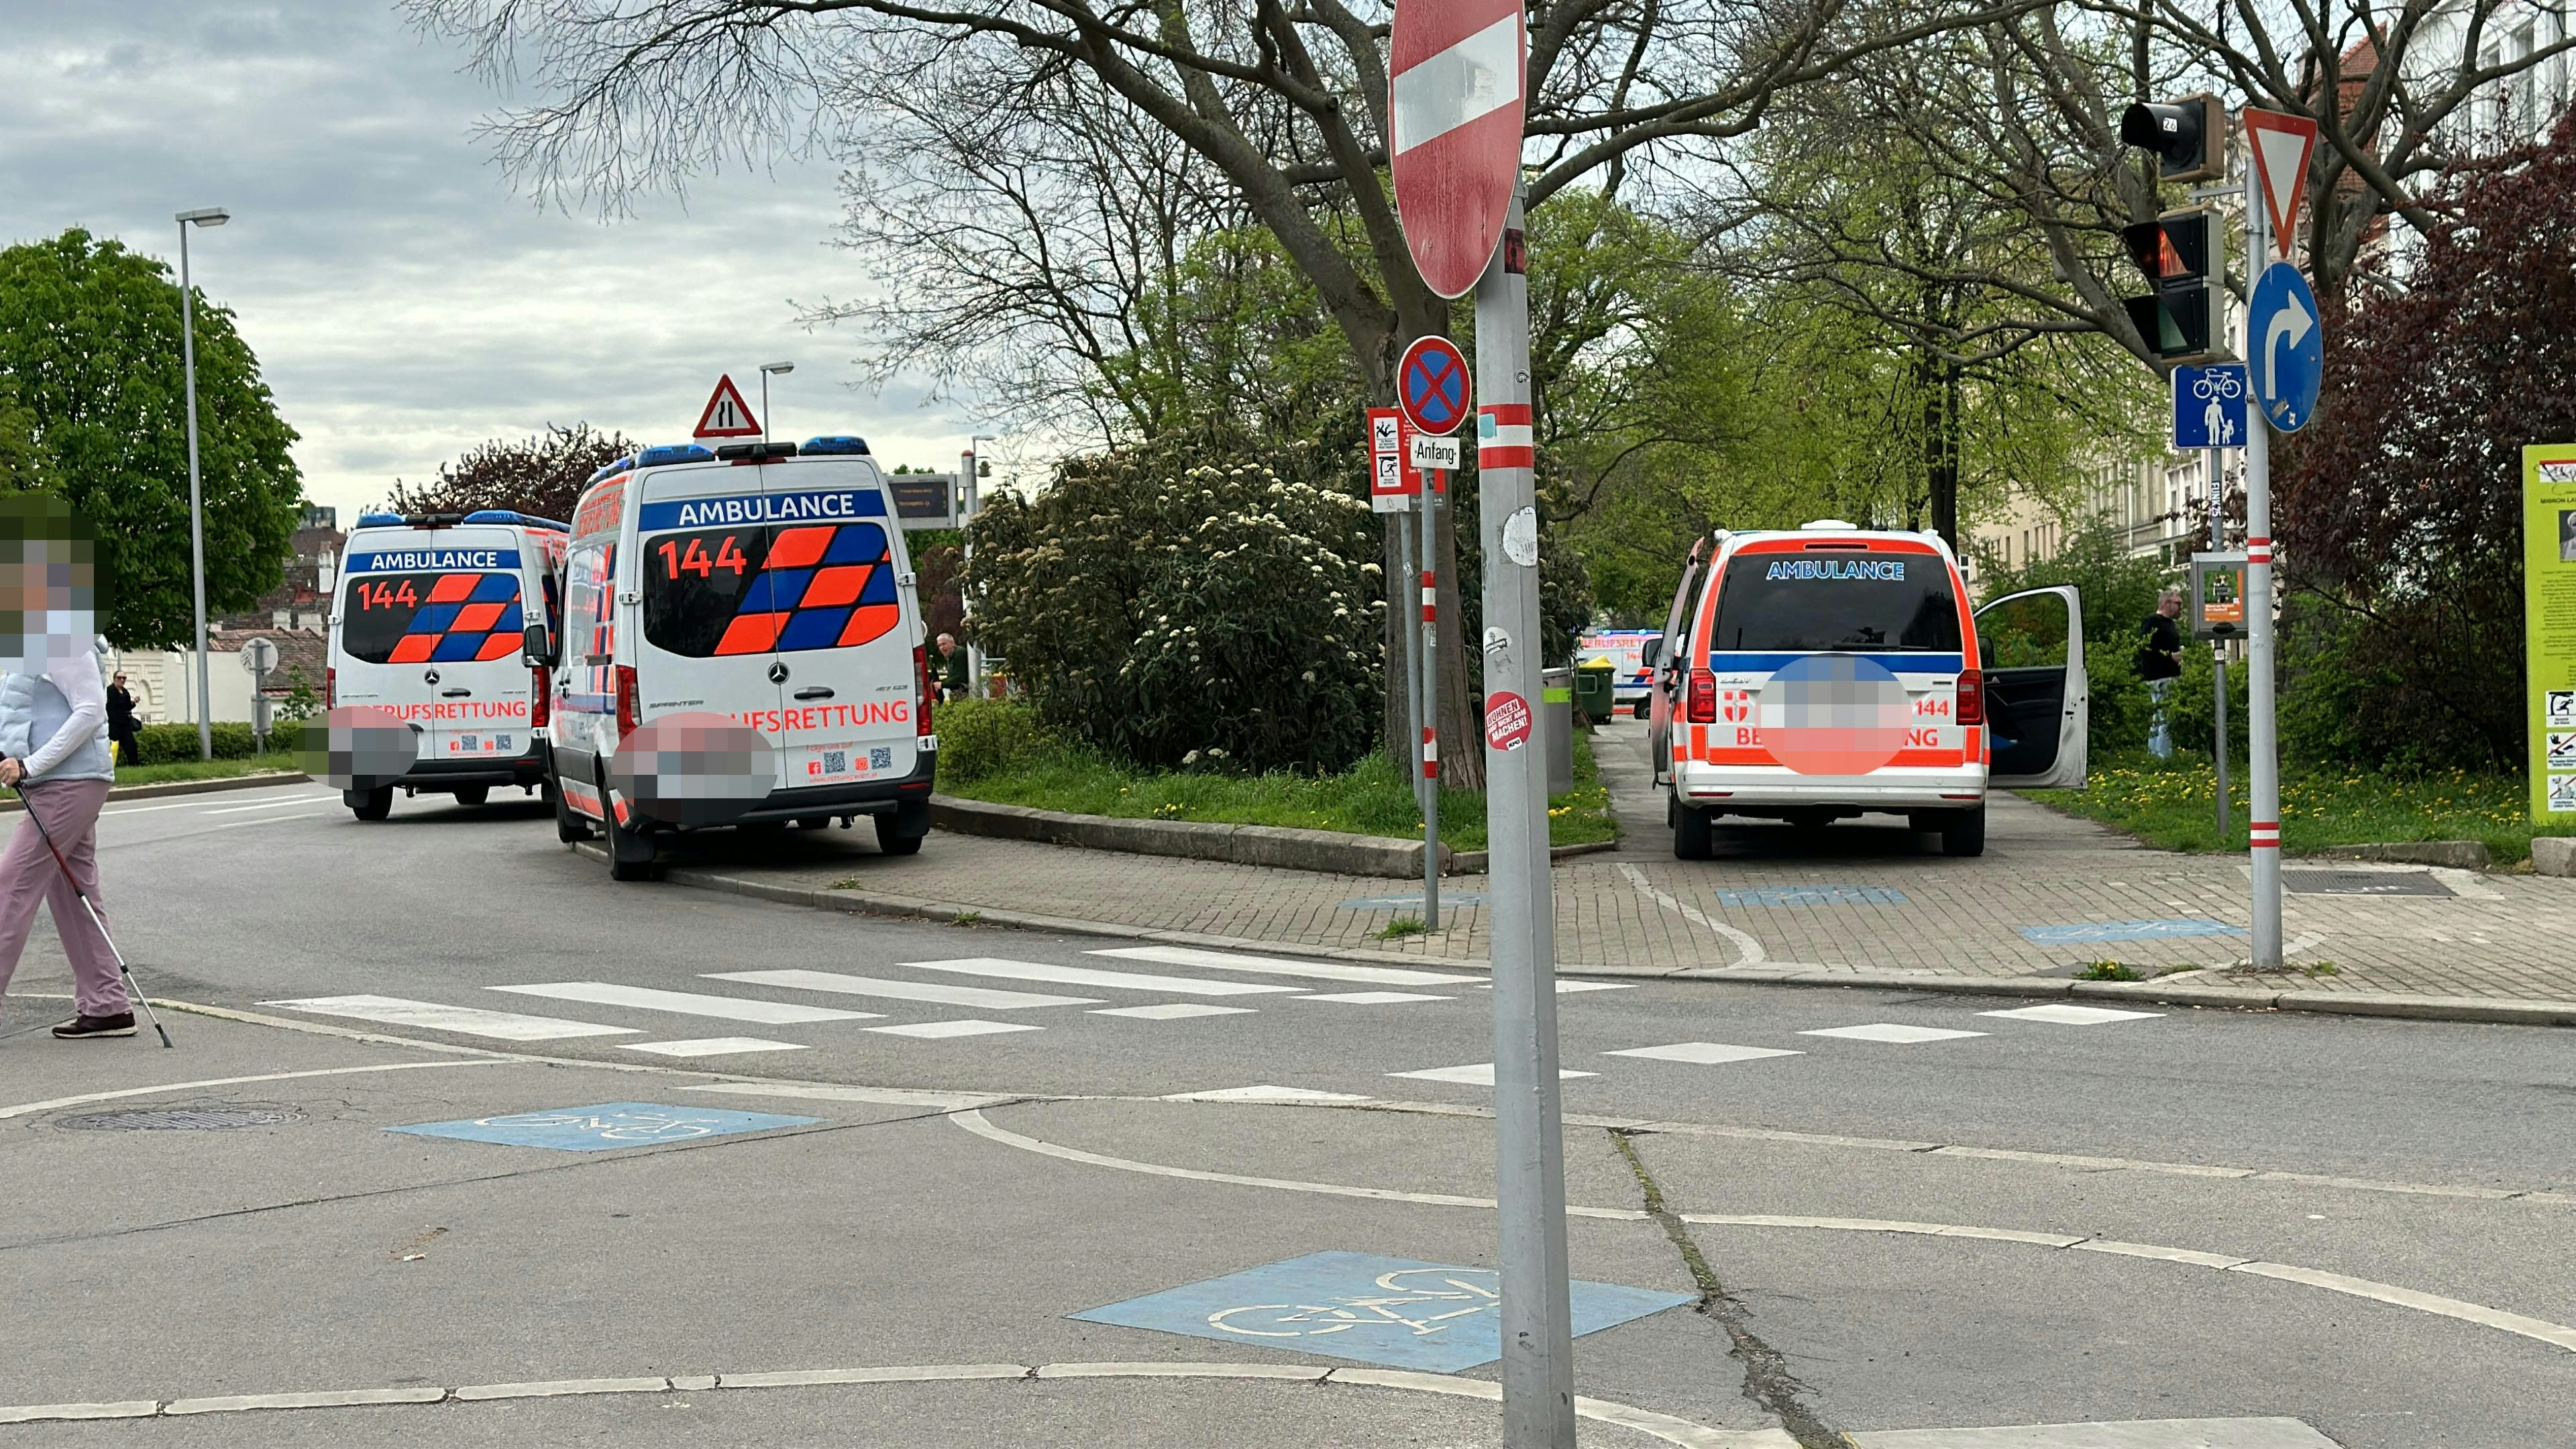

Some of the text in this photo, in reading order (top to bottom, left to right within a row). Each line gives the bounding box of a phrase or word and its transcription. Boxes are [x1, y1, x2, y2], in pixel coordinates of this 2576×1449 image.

[2164, 119, 2176, 130] 26
[1417, 441, 1454, 465] Anfang
[679, 493, 855, 526] AMBULANCE
[371, 551, 497, 570] AMBULANCE
[658, 535, 747, 580] 144
[1766, 559, 1904, 581] AMBULANCE
[357, 579, 417, 612] 144
[649, 700, 704, 708] SPRINTER
[1487, 700, 1518, 726] WOHNEN
[1915, 698, 1949, 716] 144
[1492, 716, 1527, 743] MACHEN!
